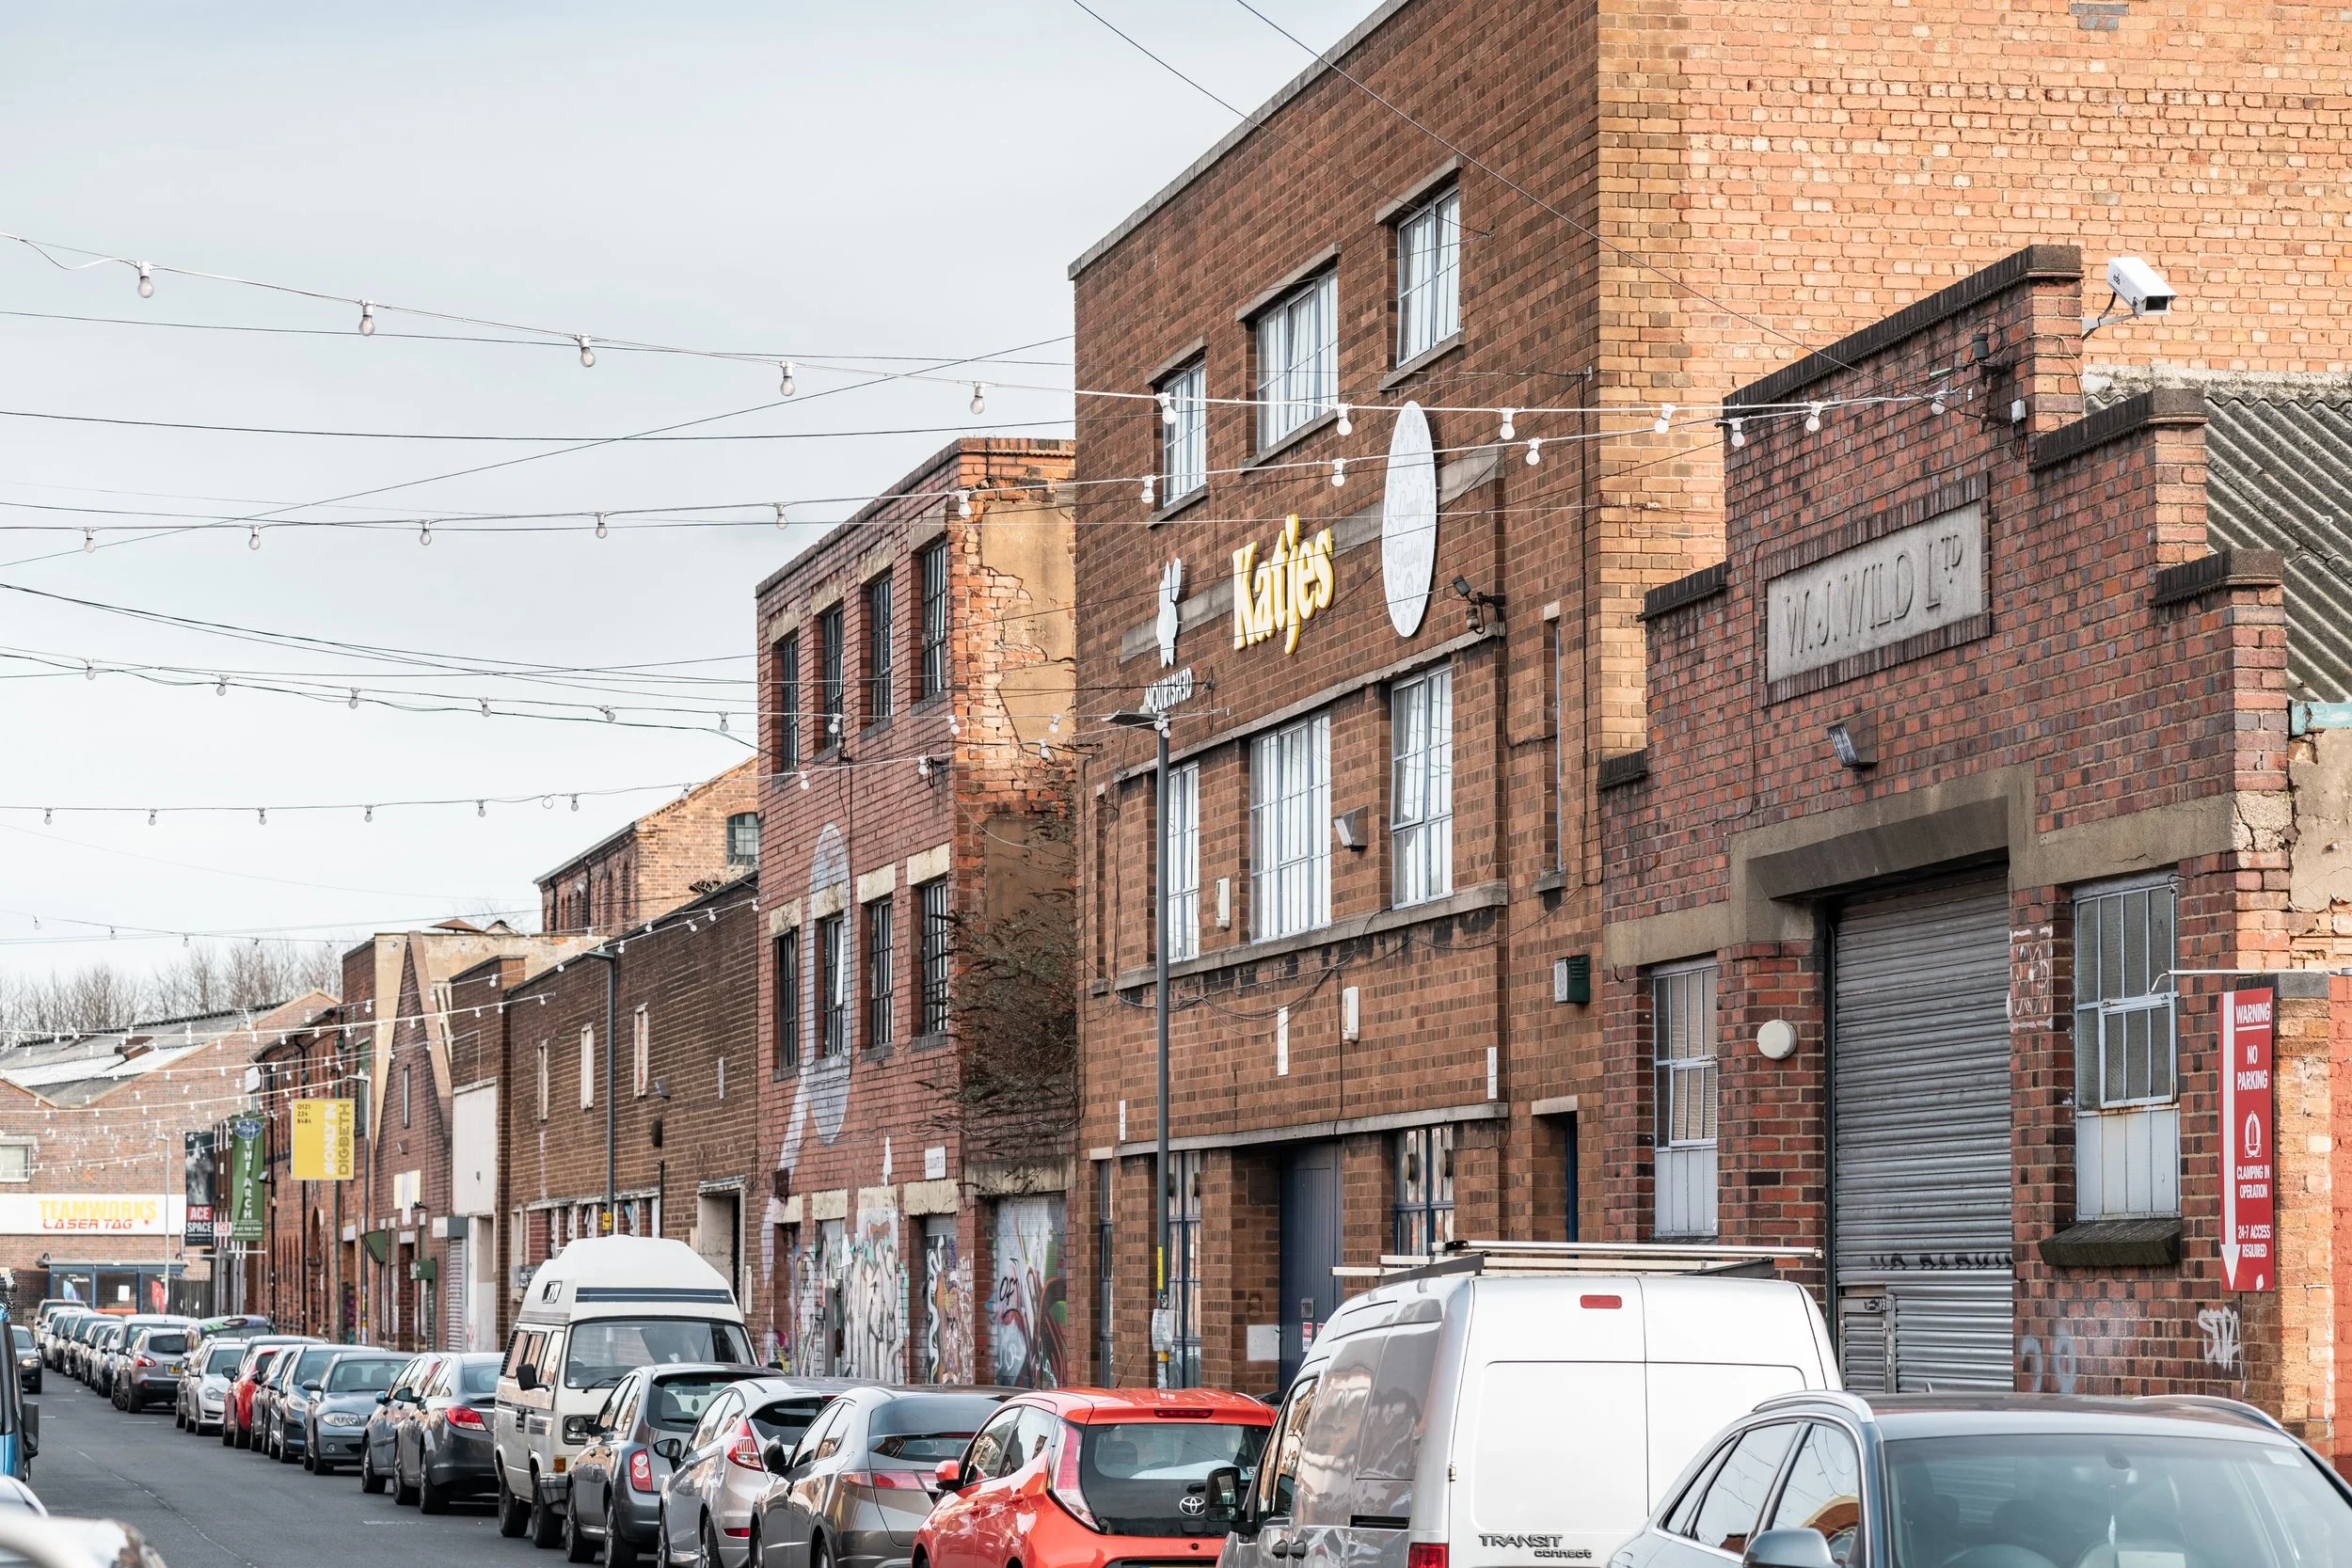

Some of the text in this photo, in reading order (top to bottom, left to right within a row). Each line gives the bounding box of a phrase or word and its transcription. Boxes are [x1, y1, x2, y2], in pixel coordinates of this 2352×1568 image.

[1232, 513, 1334, 656] Katjes
[2235, 1002, 2270, 1024] WARNING
[2247, 1044, 2258, 1065] NO
[2237, 1069, 2268, 1090] PARKING
[325, 1103, 337, 1120] IN
[339, 1103, 350, 1175] DIGBETH
[244, 1140, 253, 1219] THE ARCH
[2236, 1164, 2270, 1180] CLAMPING IN
[2239, 1183, 2267, 1198] OPERATION
[40, 1200, 157, 1220] TEAMWORKS
[190, 1207, 210, 1220] ACE
[43, 1219, 133, 1229] LASER TAG
[187, 1222, 213, 1233] SPACE
[2250, 1225, 2271, 1240] ACCESS
[2242, 1243, 2267, 1258] REQUIRED
[1479, 1533, 1563, 1548] TRANSIT
[1534, 1548, 1592, 1559] connect
